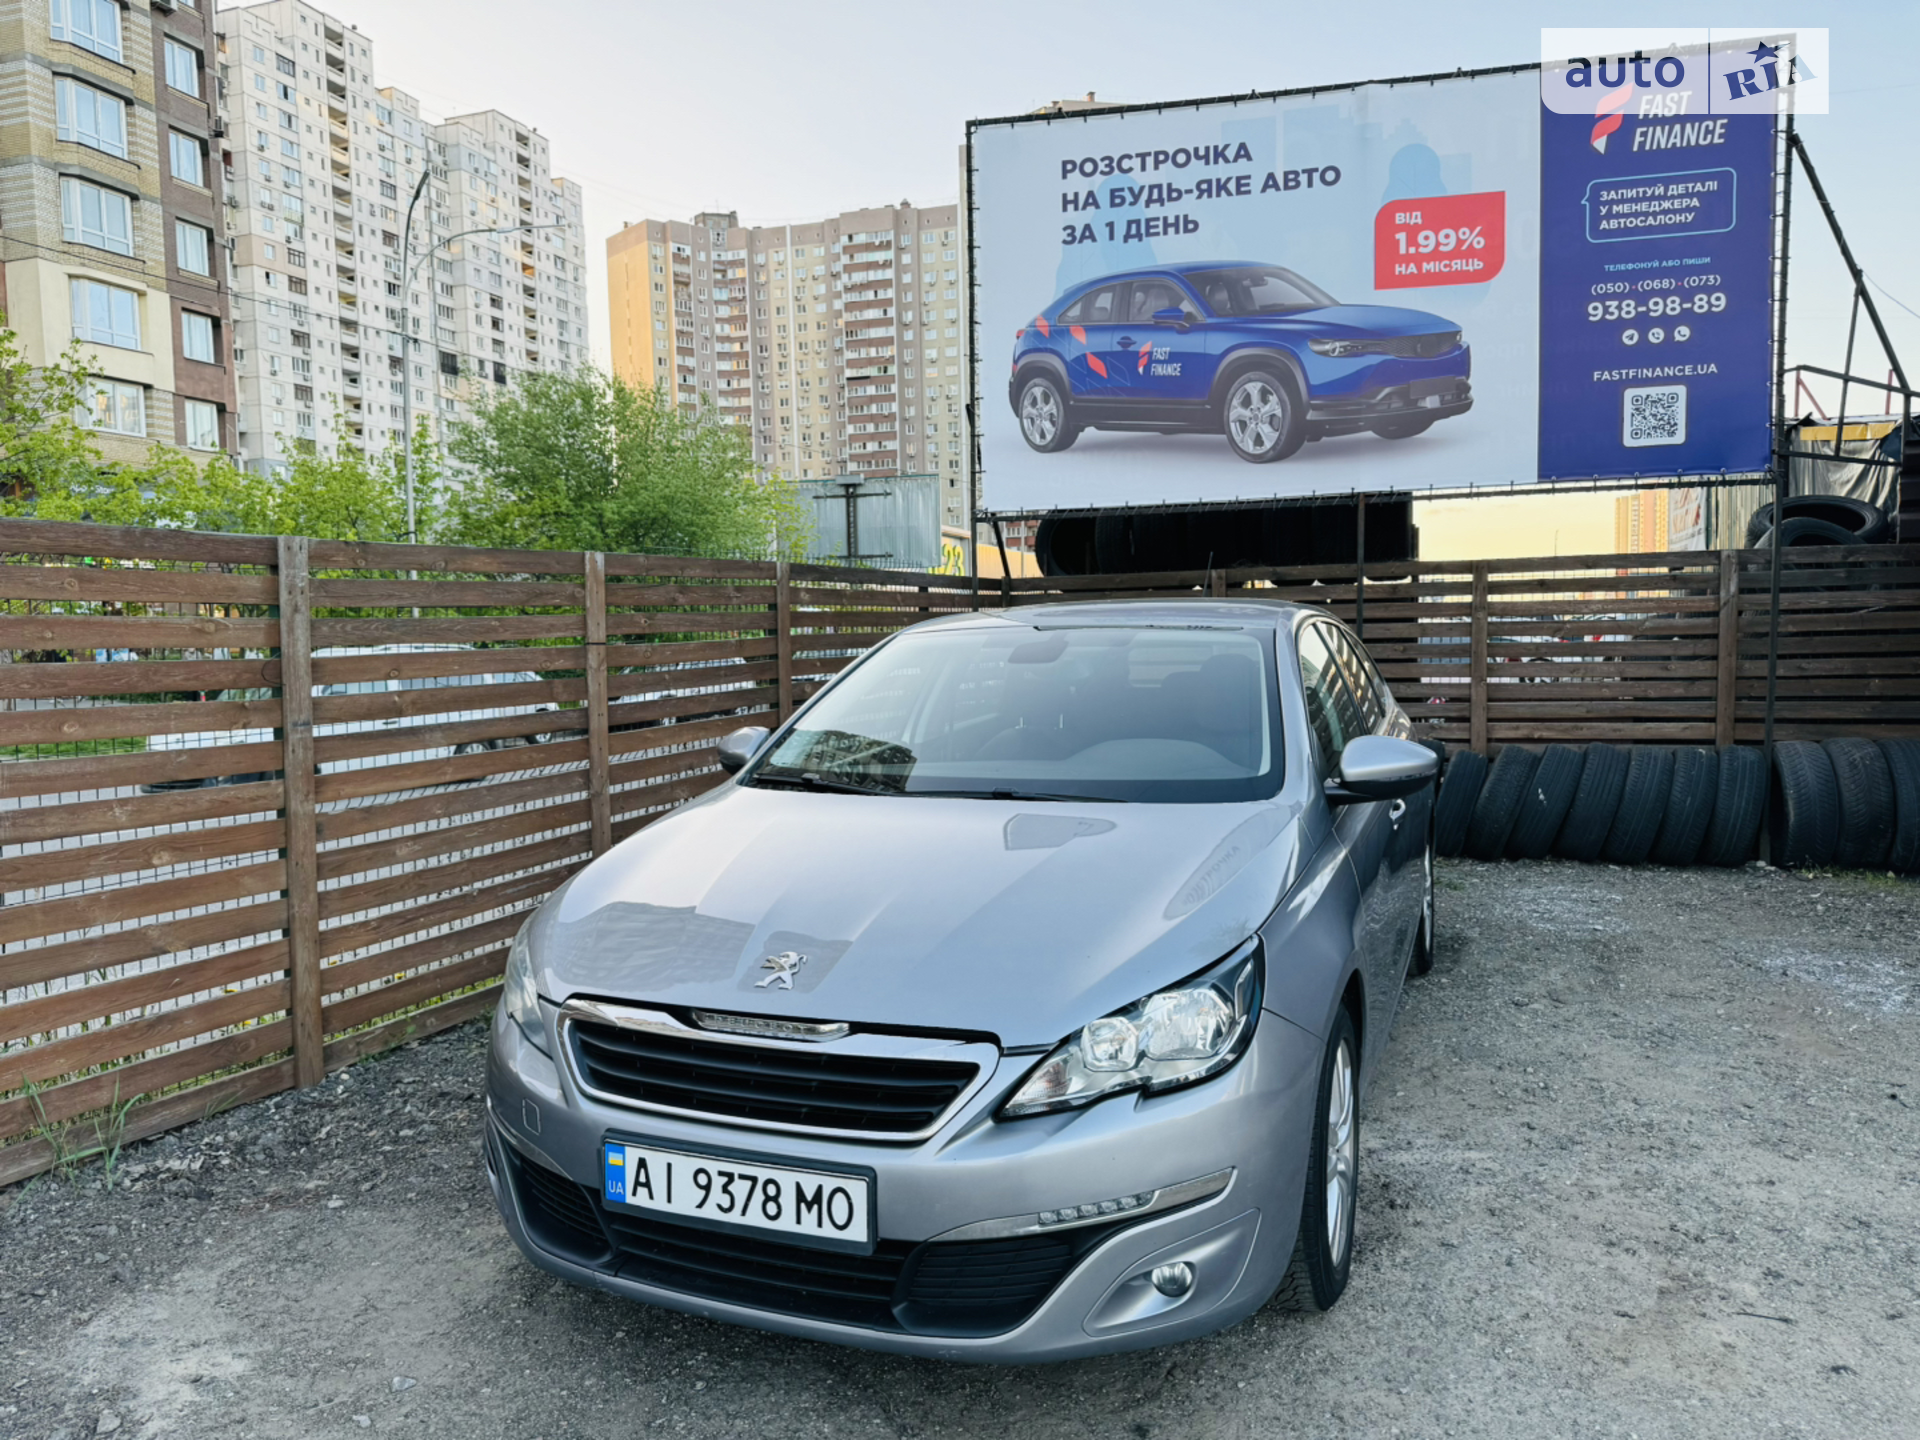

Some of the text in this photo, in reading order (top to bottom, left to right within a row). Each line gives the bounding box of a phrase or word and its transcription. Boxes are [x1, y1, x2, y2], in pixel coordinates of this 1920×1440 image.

[1638, 91, 1692, 119] FAST
[1633, 119, 1728, 152] FINANCE
[1061, 141, 1253, 180] РОЗСТРОЧКА
[1061, 165, 1342, 213] НА БУДЬ-ЯКЕ АВТО
[1600, 180, 1718, 201] ЗАПИТУЙ ДЕТАЛІ
[1599, 197, 1700, 216] У МЕНЕДЖЕРА
[1395, 211, 1422, 225] ВІД
[1599, 212, 1695, 230] АВТОСАЛОНУ
[1061, 214, 1199, 245] ЗА 1 ДЕНЬ
[1394, 226, 1485, 255] 1.99%
[1395, 258, 1484, 275] НА МІСЯЦЬ
[1604, 257, 1711, 271] ТЕЛЕФОНУЙ АБО ПИШИ
[1587, 292, 1727, 321] 938-98-89
[1152, 347, 1171, 360] FAST
[1150, 363, 1182, 376] FINANCE
[1593, 363, 1718, 382] FASTFINANCE.UA
[608, 1180, 624, 1196] UA
[631, 1157, 854, 1231] AI 9378 MO
